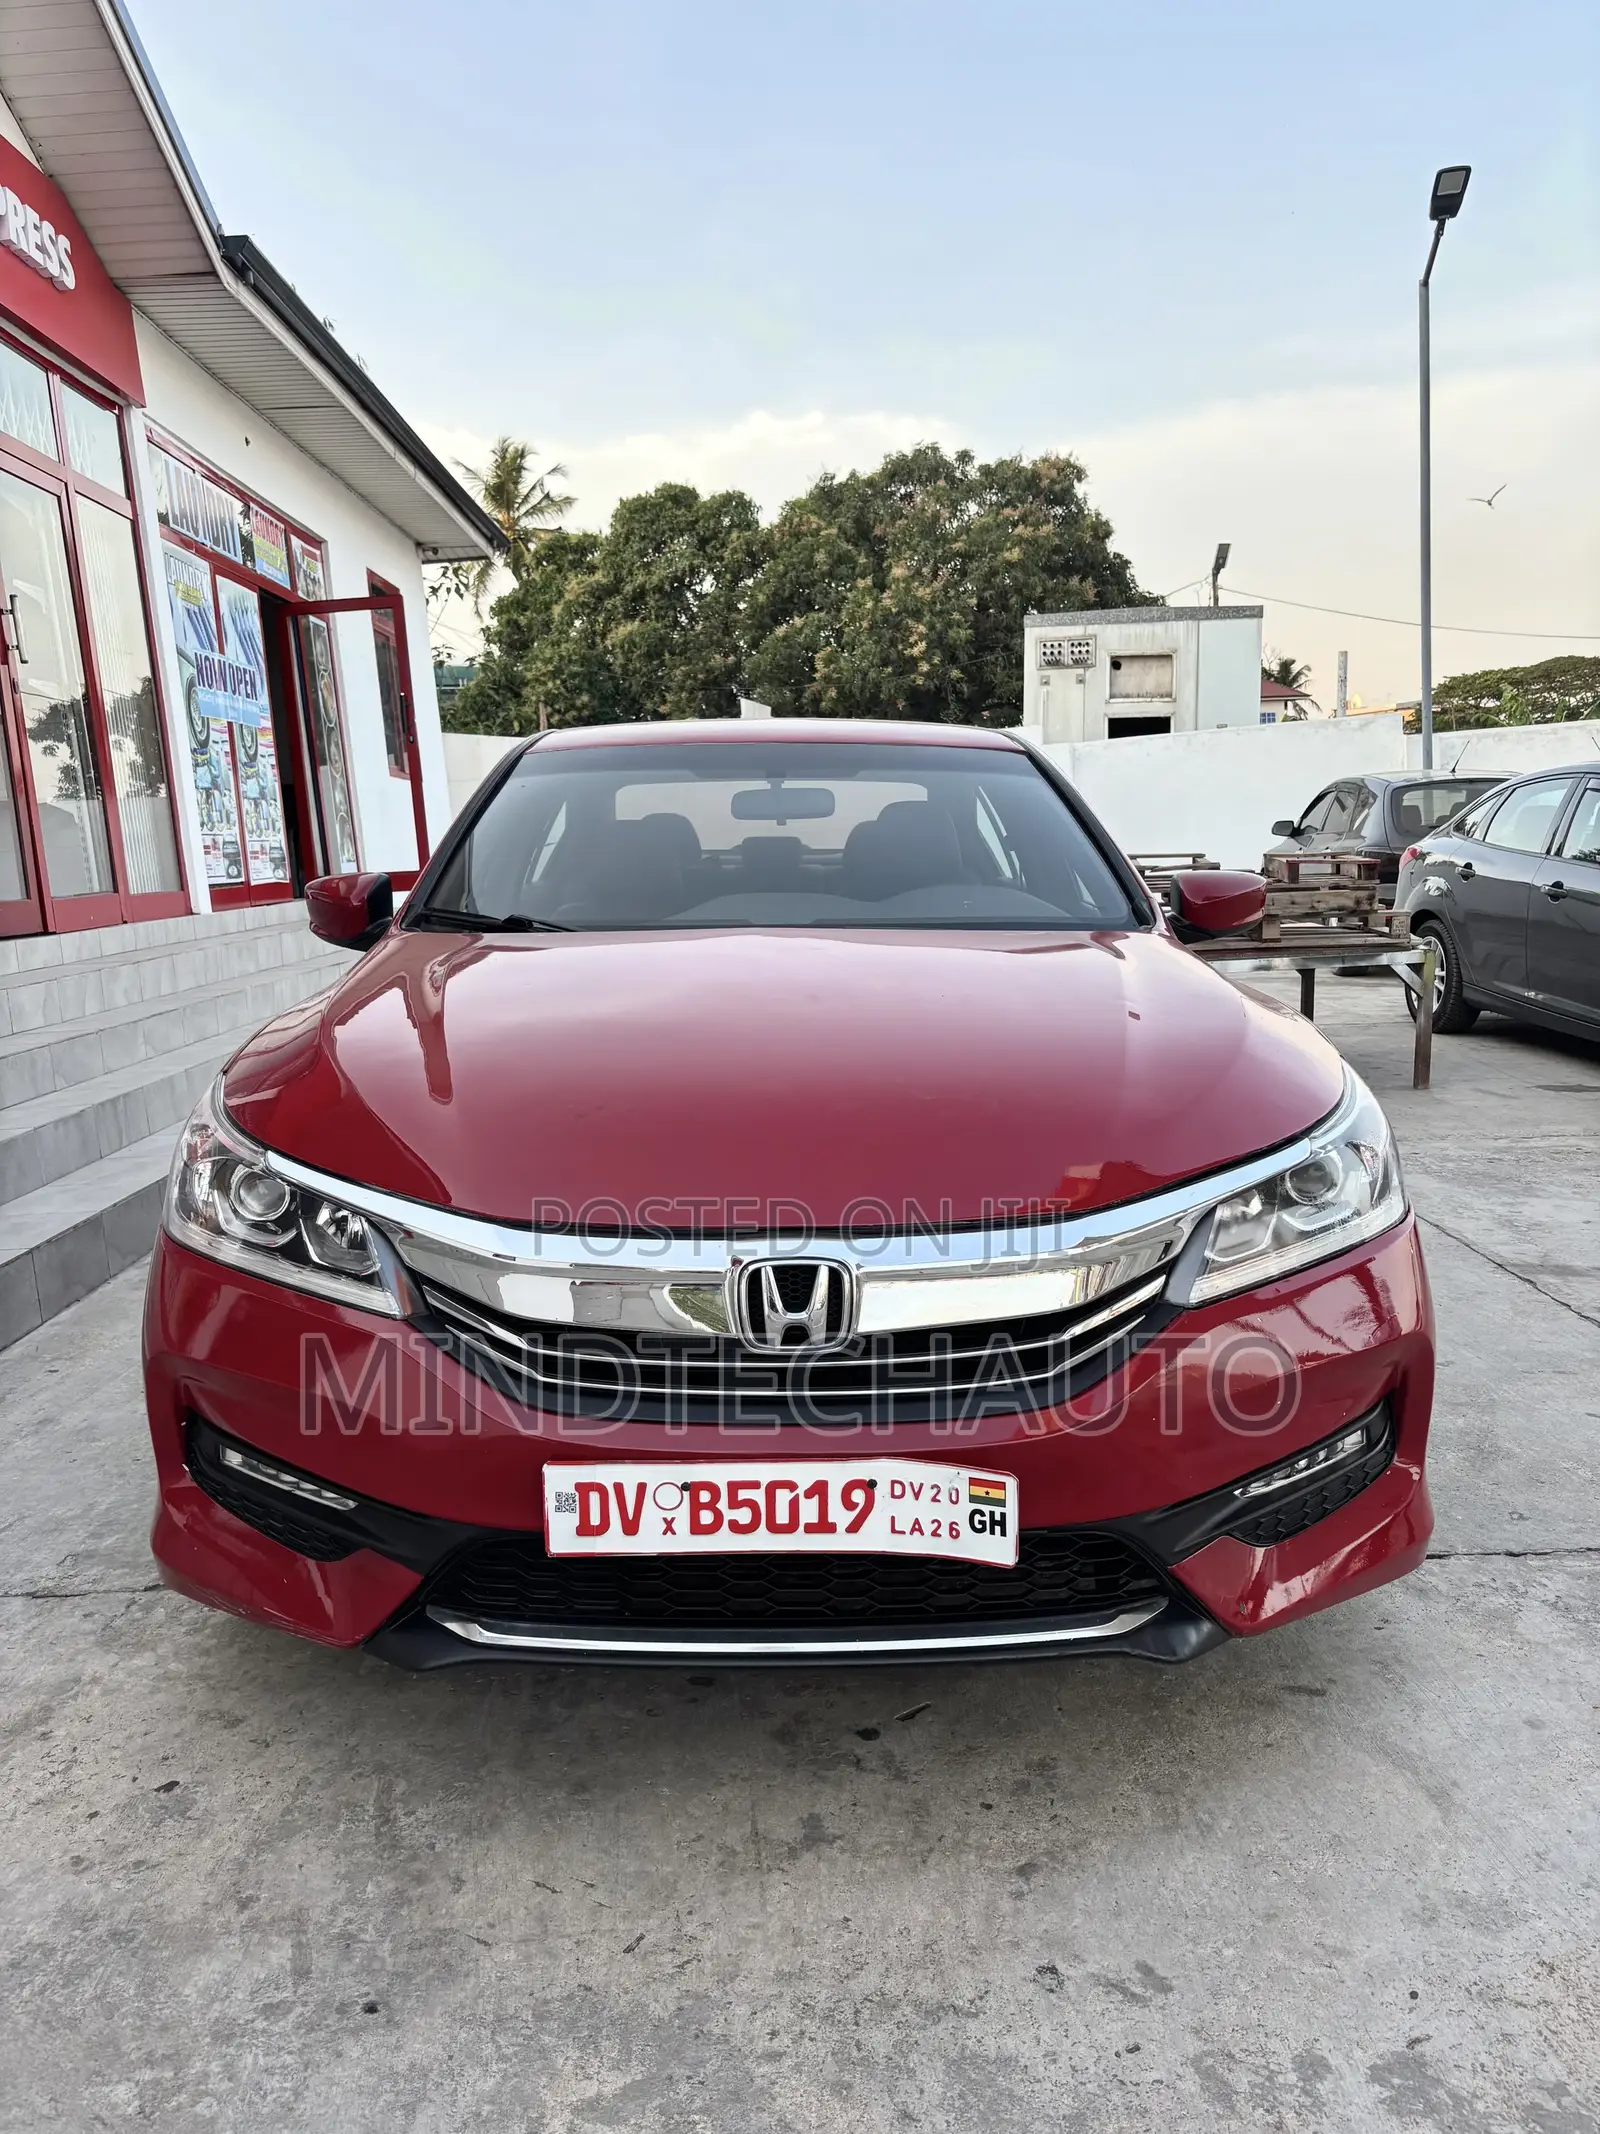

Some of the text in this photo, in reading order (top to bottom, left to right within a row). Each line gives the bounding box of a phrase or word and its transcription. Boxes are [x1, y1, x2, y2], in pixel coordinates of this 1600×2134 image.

[164, 458, 241, 562] LAUNDRY
[194, 652, 227, 692] NOW
[228, 663, 258, 701] OPEN
[574, 1482, 648, 1536] DV
[689, 1479, 876, 1535] B5019
[968, 1508, 1007, 1537] GH
